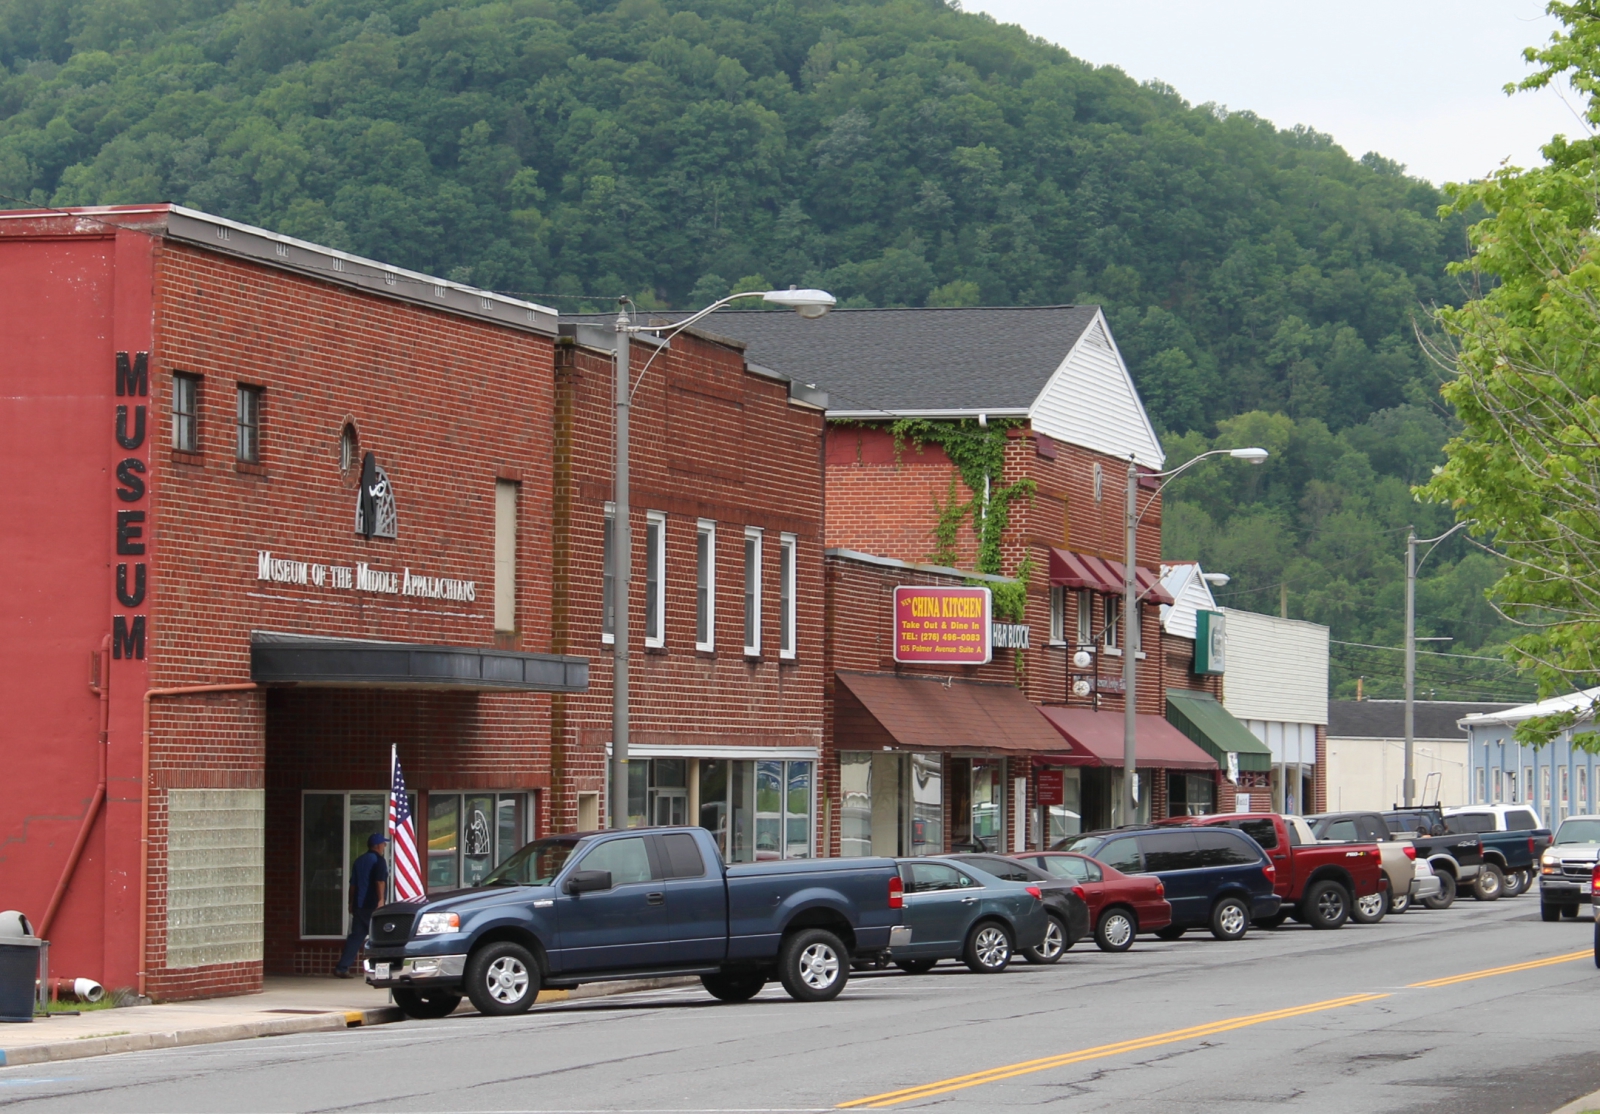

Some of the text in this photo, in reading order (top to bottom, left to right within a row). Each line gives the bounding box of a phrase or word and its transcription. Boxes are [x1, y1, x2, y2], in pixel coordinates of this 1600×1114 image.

[113, 350, 148, 660] MUSEUM
[257, 550, 476, 602] MUSEUM OF THE MIDDLE APPALACHIANS
[911, 596, 940, 618] CHINA
[942, 597, 982, 618] KITCHEN
[901, 620, 920, 629] Take
[923, 621, 938, 629] Out
[941, 621, 947, 629] &
[971, 622, 980, 630] In
[993, 623, 1030, 649] H&R BLOCK
[901, 632, 918, 641] TEL:
[911, 644, 933, 653] Palmer
[934, 645, 957, 653] Avenue
